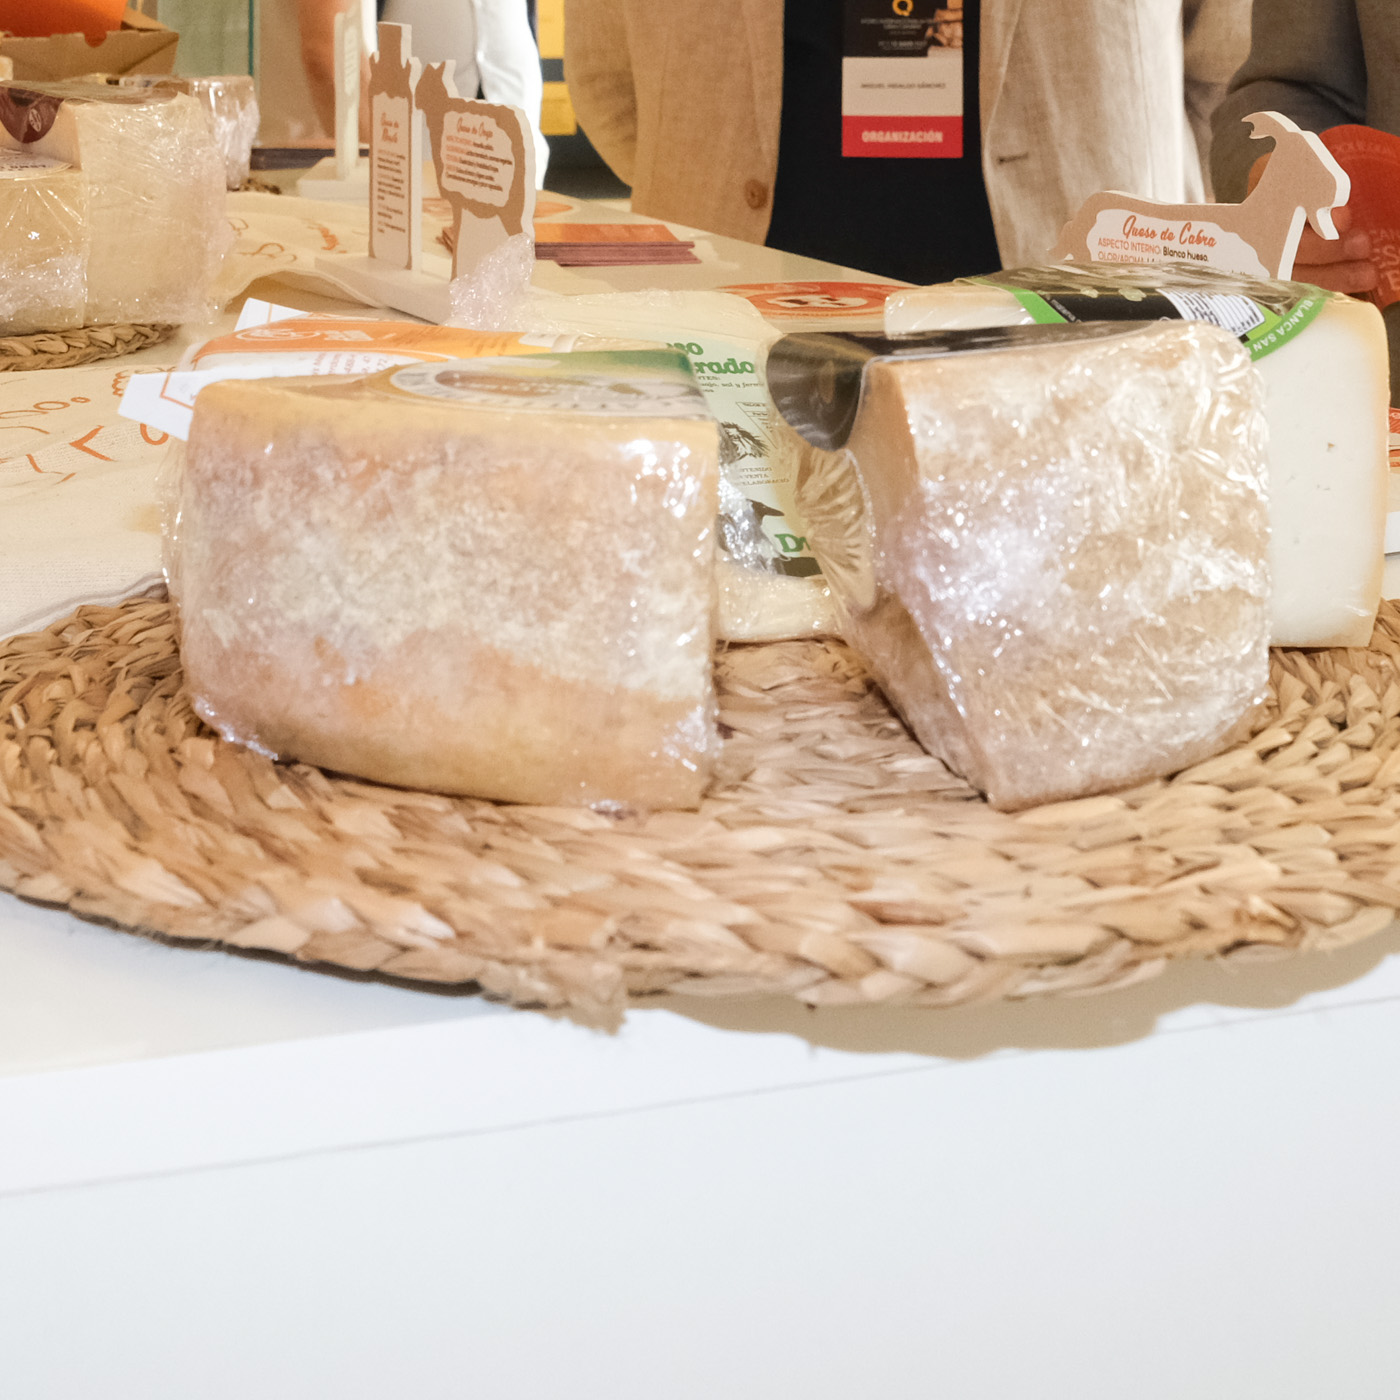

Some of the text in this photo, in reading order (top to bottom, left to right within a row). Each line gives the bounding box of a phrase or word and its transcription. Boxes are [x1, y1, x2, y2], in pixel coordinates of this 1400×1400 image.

[861, 130, 943, 143] ORGANIZACIÓN
[1122, 215, 1217, 248] Queso de Cabra
[1098, 237, 1130, 251] ASPECTO
[1163, 246, 1186, 259] Blanco
[1252, 299, 1314, 352] BLANCA SAN
